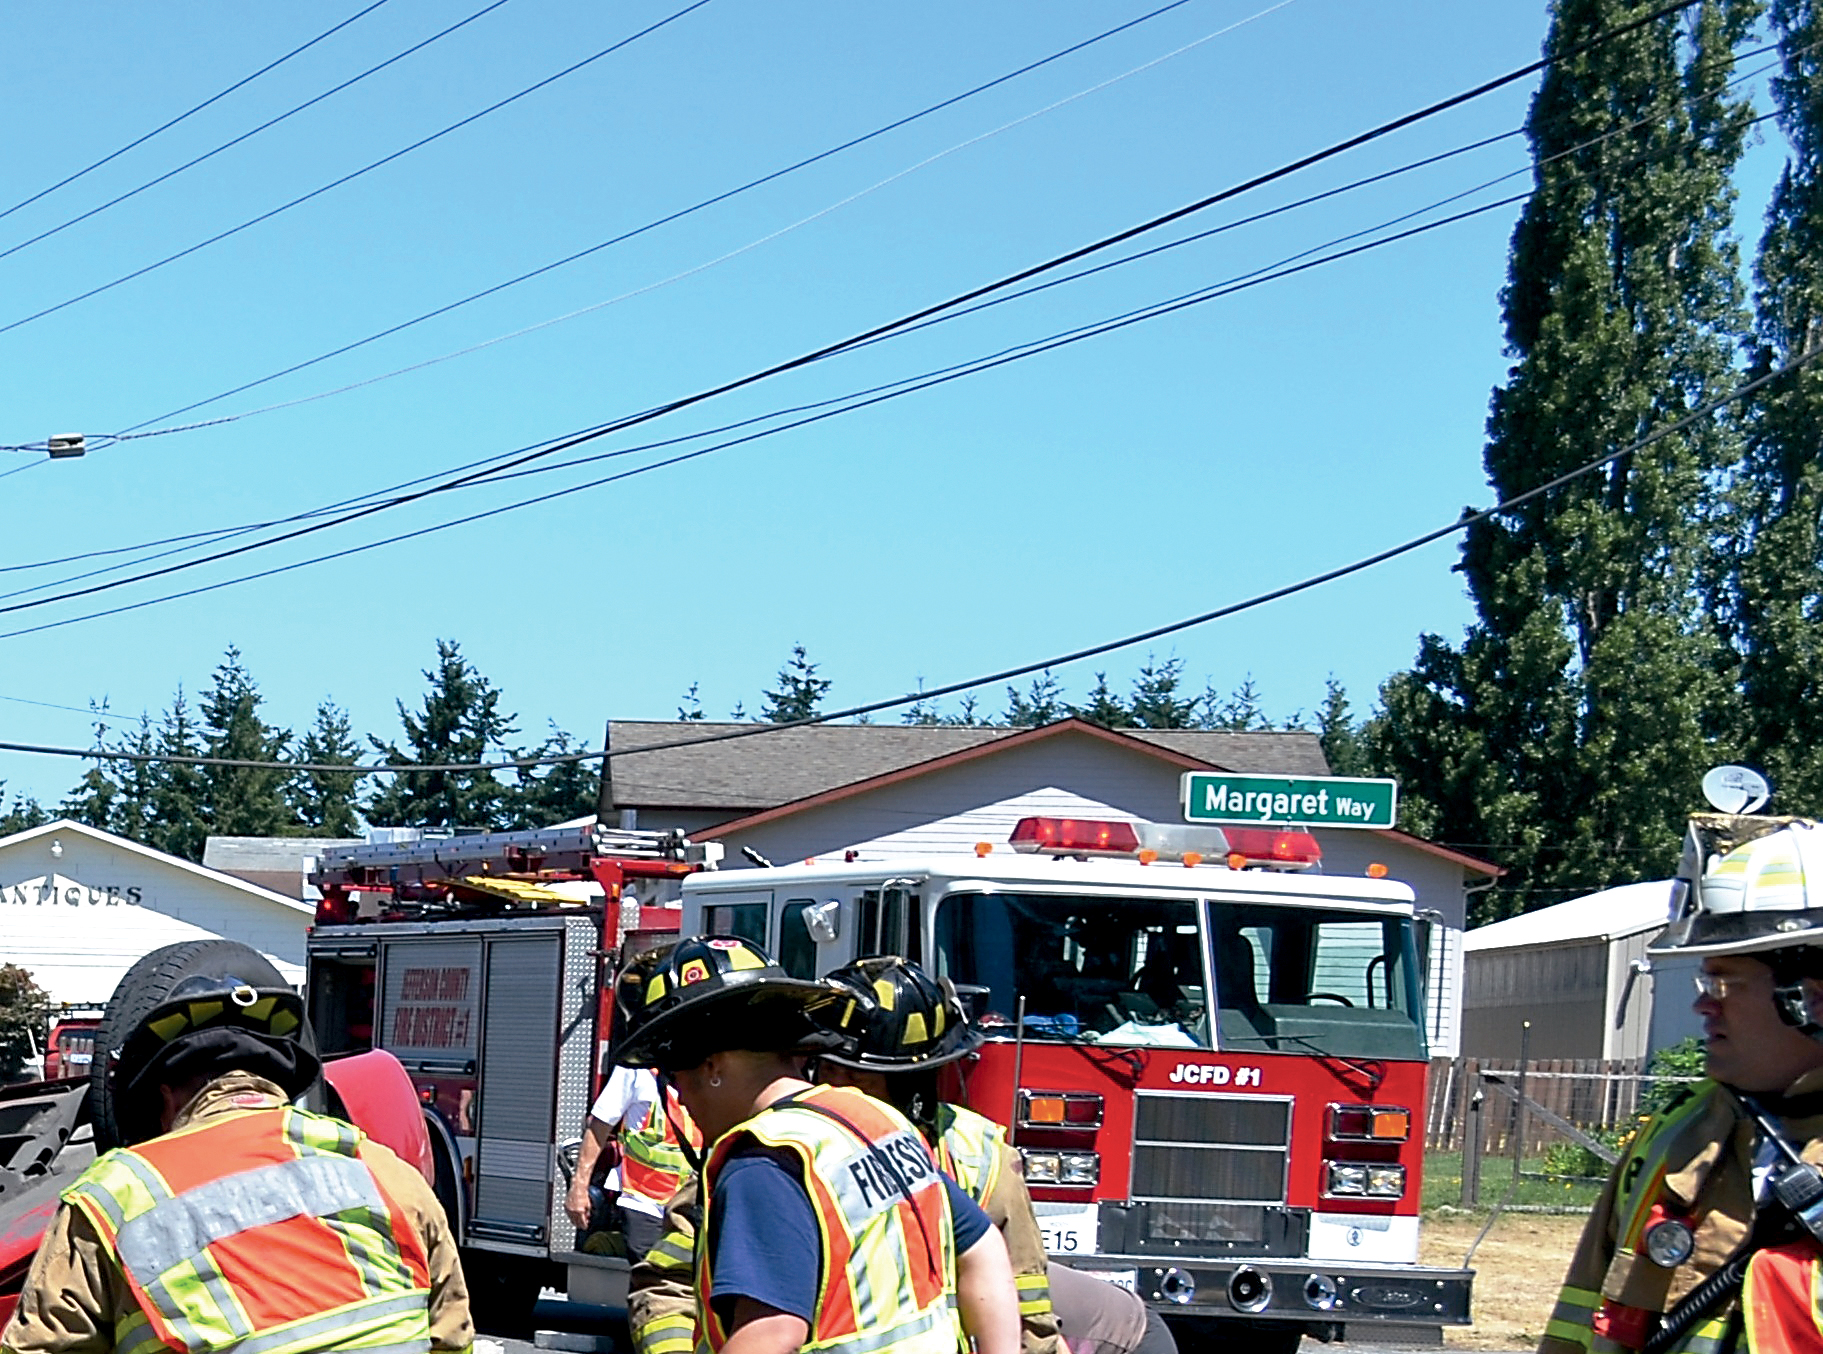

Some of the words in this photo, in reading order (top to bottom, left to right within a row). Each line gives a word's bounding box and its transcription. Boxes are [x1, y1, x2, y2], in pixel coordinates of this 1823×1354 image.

[1205, 784, 1329, 821] Margaret
[1336, 797, 1375, 821] Way
[1169, 1064, 1230, 1085] JCFD
[1235, 1067, 1261, 1087] #1
